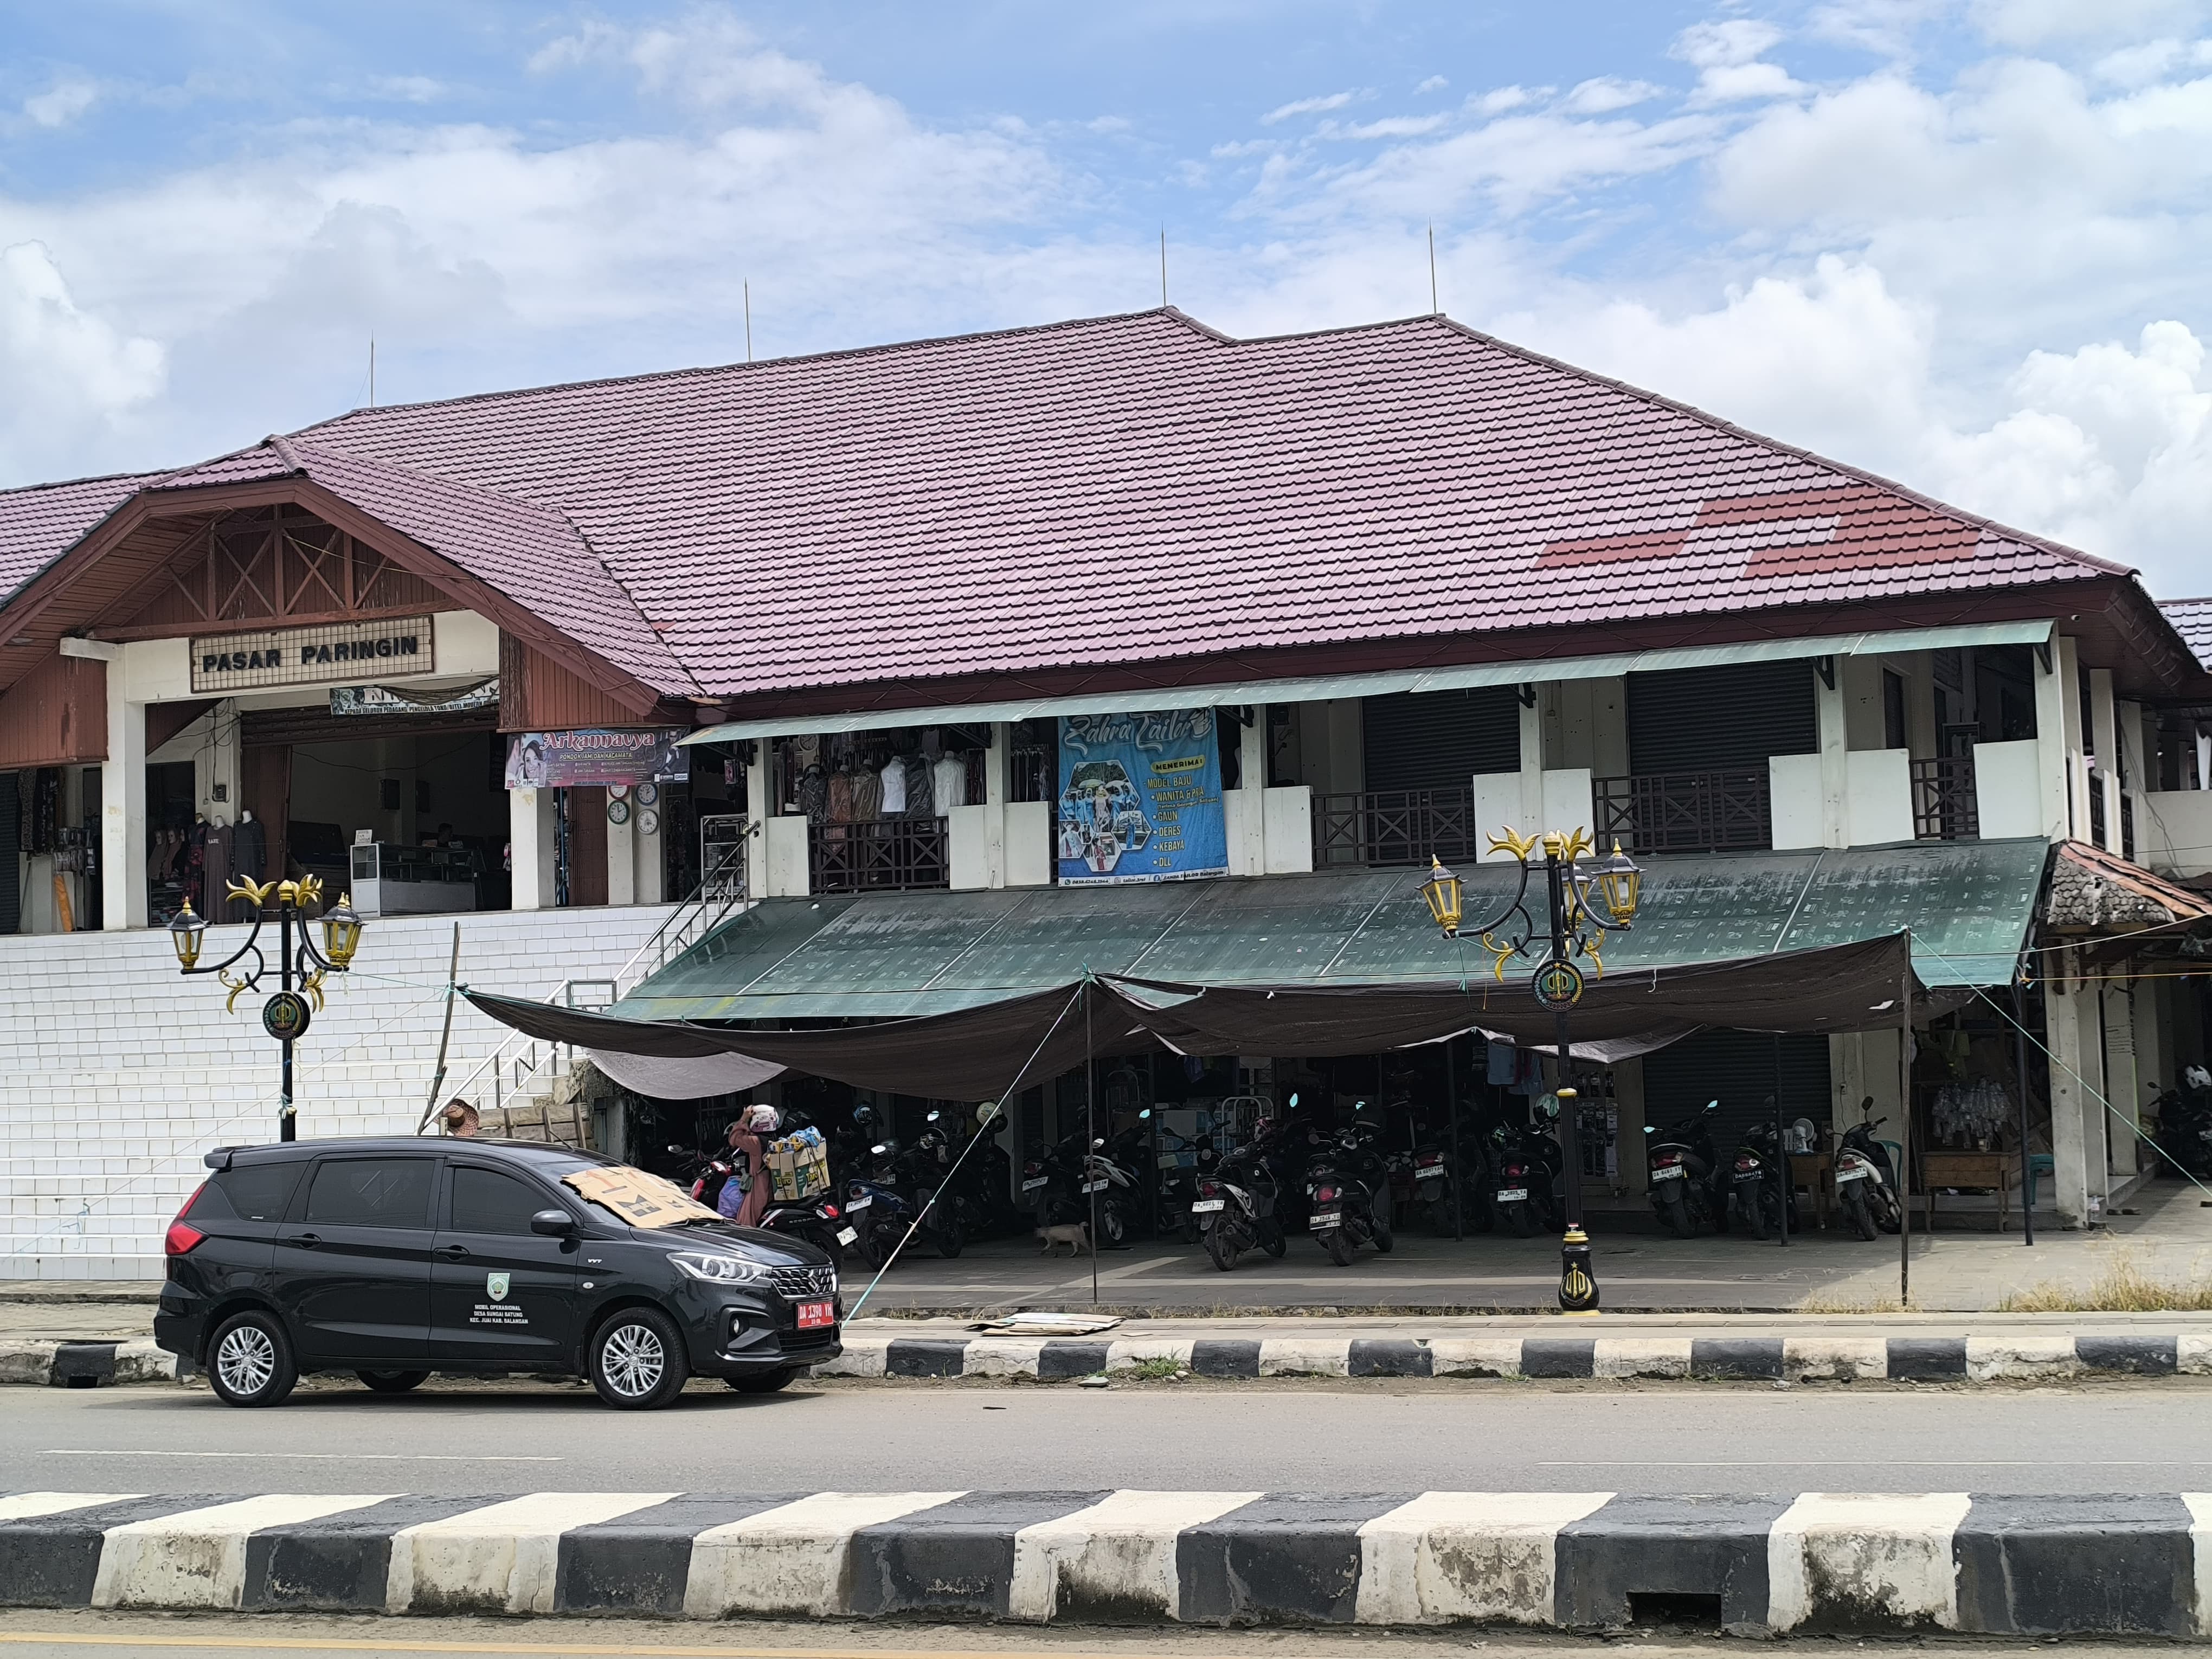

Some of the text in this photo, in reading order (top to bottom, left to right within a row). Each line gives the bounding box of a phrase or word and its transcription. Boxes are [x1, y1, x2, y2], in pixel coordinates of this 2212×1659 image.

[203, 636, 417, 672] PASAR PARINGIN
[1064, 710, 1191, 755] Zahra Tailor
[539, 731, 655, 751] Arkannavya
[1147, 775, 1192, 789] MODEL BAJU
[1156, 786, 1204, 802] WANITA & PRIA
[1158, 811, 1178, 821] GAUN
[1159, 825, 1181, 837] DERES
[1159, 839, 1185, 851] KEBAYA
[1159, 857, 1172, 867] DLL
[799, 1303, 832, 1320] DA 1398 YH
